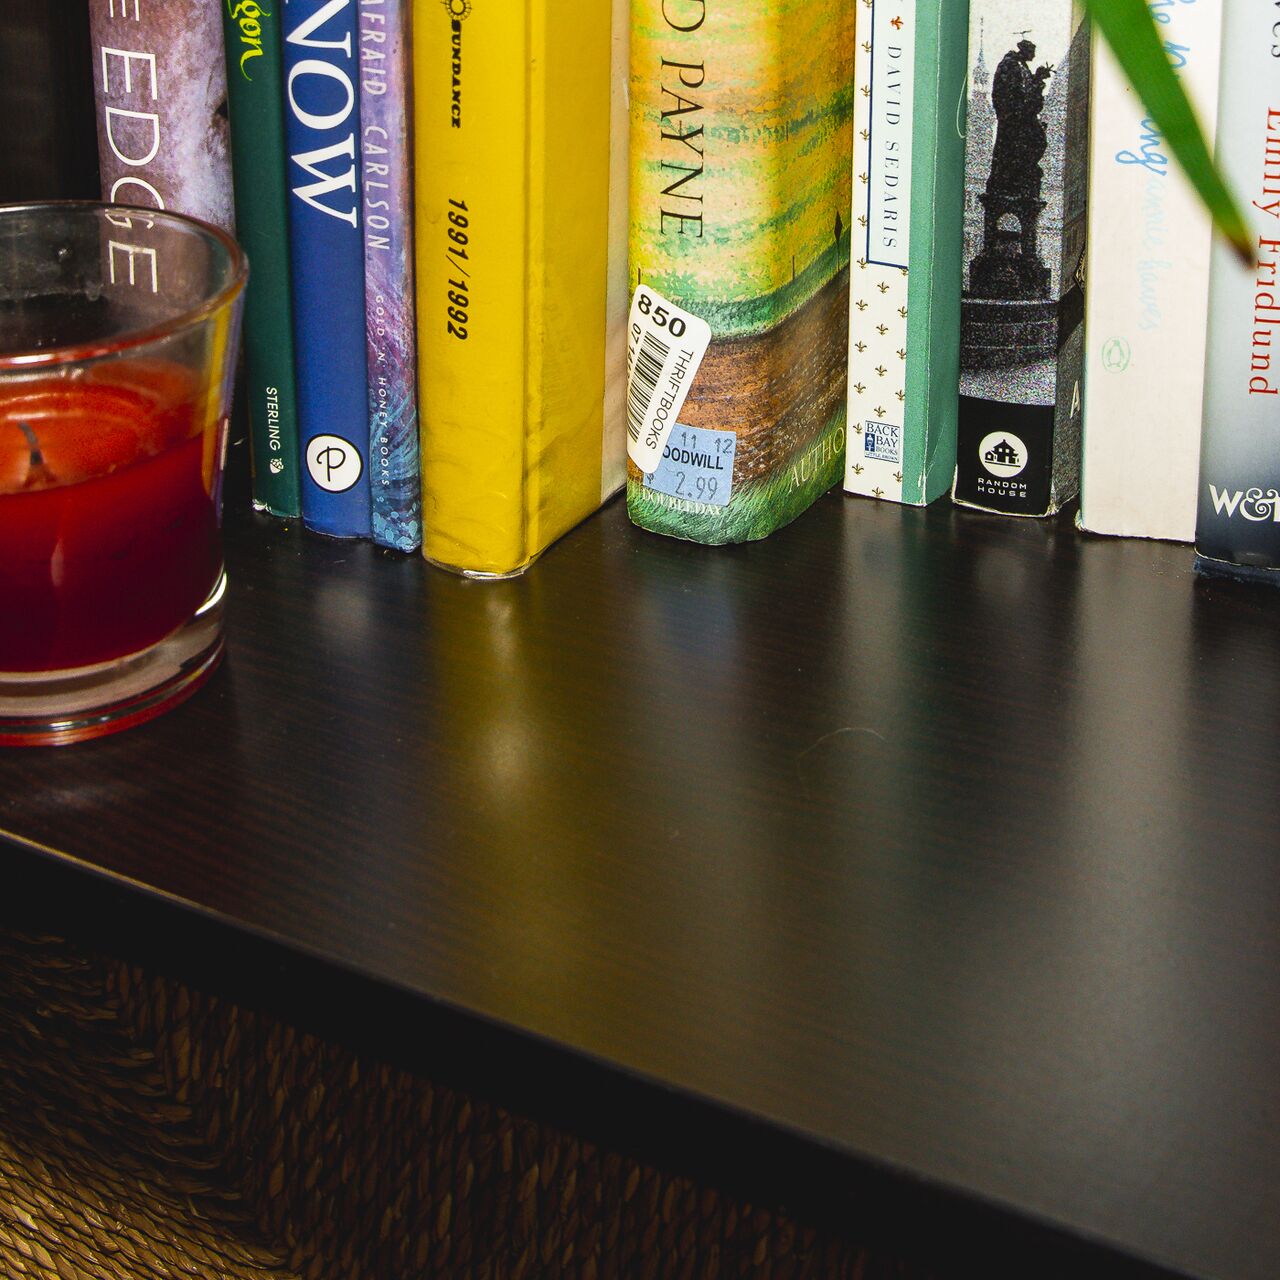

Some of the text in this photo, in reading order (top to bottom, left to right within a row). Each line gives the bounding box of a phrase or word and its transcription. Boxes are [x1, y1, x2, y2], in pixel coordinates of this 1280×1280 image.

[452, 19, 462, 128] SUNDANCE
[101, 45, 166, 293] EDGE
[659, 58, 705, 239] PAYNE
[881, 45, 902, 249] DAVID SEDARIS
[364, 126, 392, 251] CARLSON
[447, 198, 471, 340] 1991/1992
[376, 295, 385, 336] GOLD
[638, 294, 686, 337] 850
[265, 386, 282, 452] STERLING
[378, 377, 388, 428] HONEY
[646, 349, 694, 450] THRIFTBOOKS
[662, 445, 724, 470] OODWILL
[867, 423, 898, 437] BACK
[876, 436, 898, 447] BAY
[380, 437, 390, 486] BOOKS
[789, 428, 844, 493] AUTHO
[978, 478, 1026, 489] RANDOM
[978, 486, 1026, 497] HOUSE
